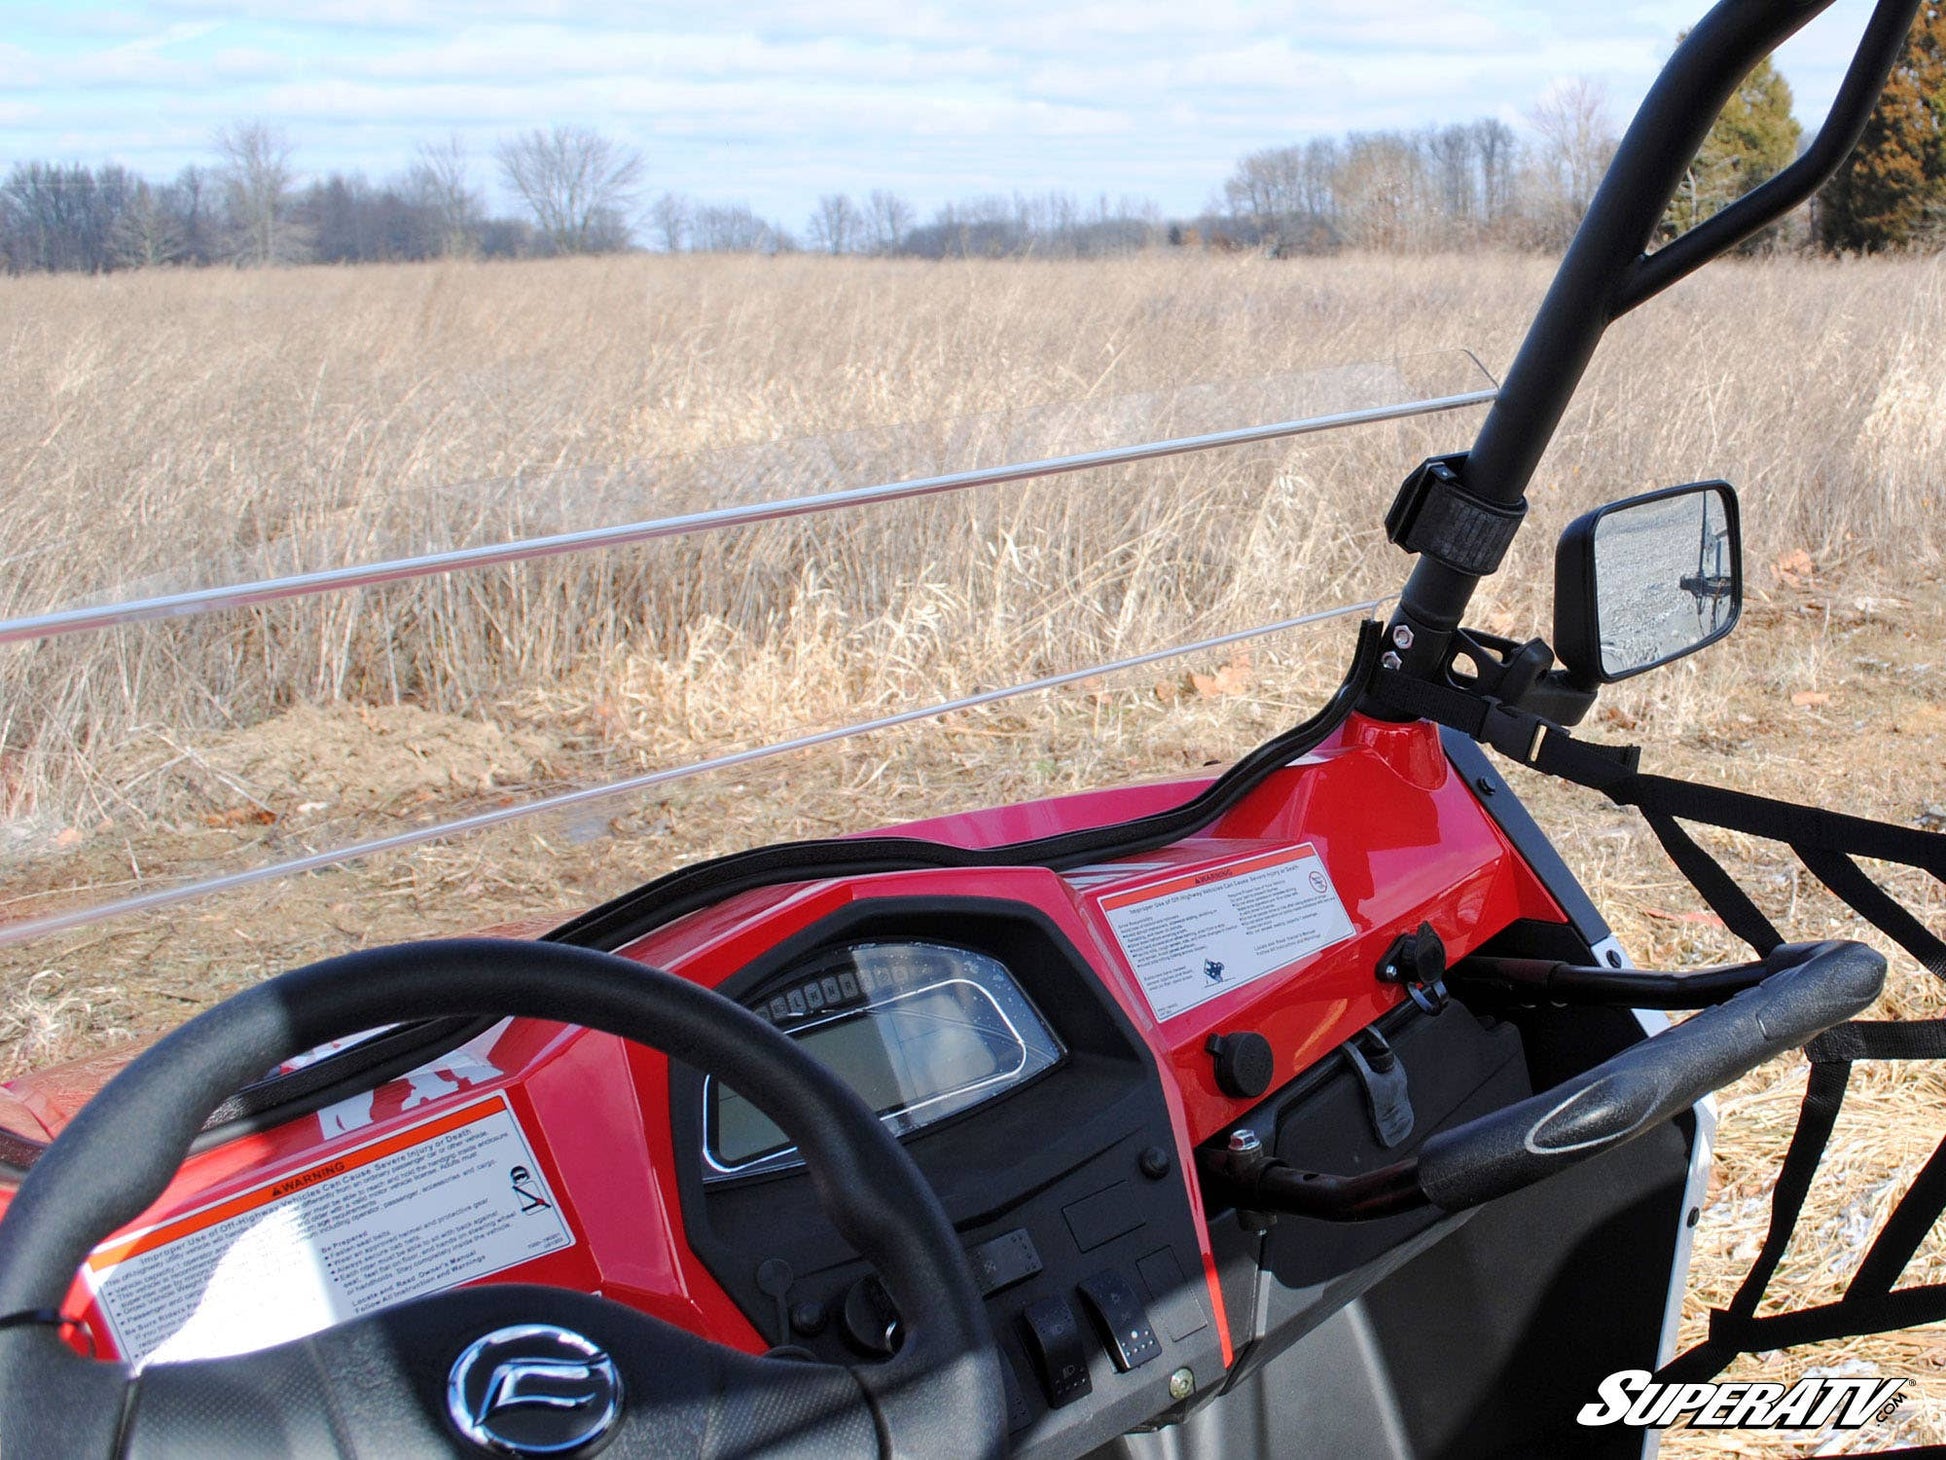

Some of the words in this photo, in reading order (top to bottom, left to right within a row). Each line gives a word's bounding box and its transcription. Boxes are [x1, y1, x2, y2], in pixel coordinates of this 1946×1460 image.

[141, 1242, 185, 1265] Improper
[188, 1234, 206, 1246] Use
[208, 1229, 218, 1237] of
[221, 1204, 280, 1233] Off-Highway
[282, 1188, 321, 1208] Vehicles
[323, 1180, 341, 1191] Can
[342, 1168, 371, 1184] Cause
[375, 1154, 406, 1171] Severe
[407, 1144, 433, 1158] Injury
[434, 1139, 444, 1147] or
[446, 1128, 471, 1142] Death
[283, 1162, 346, 1192] WARNING
